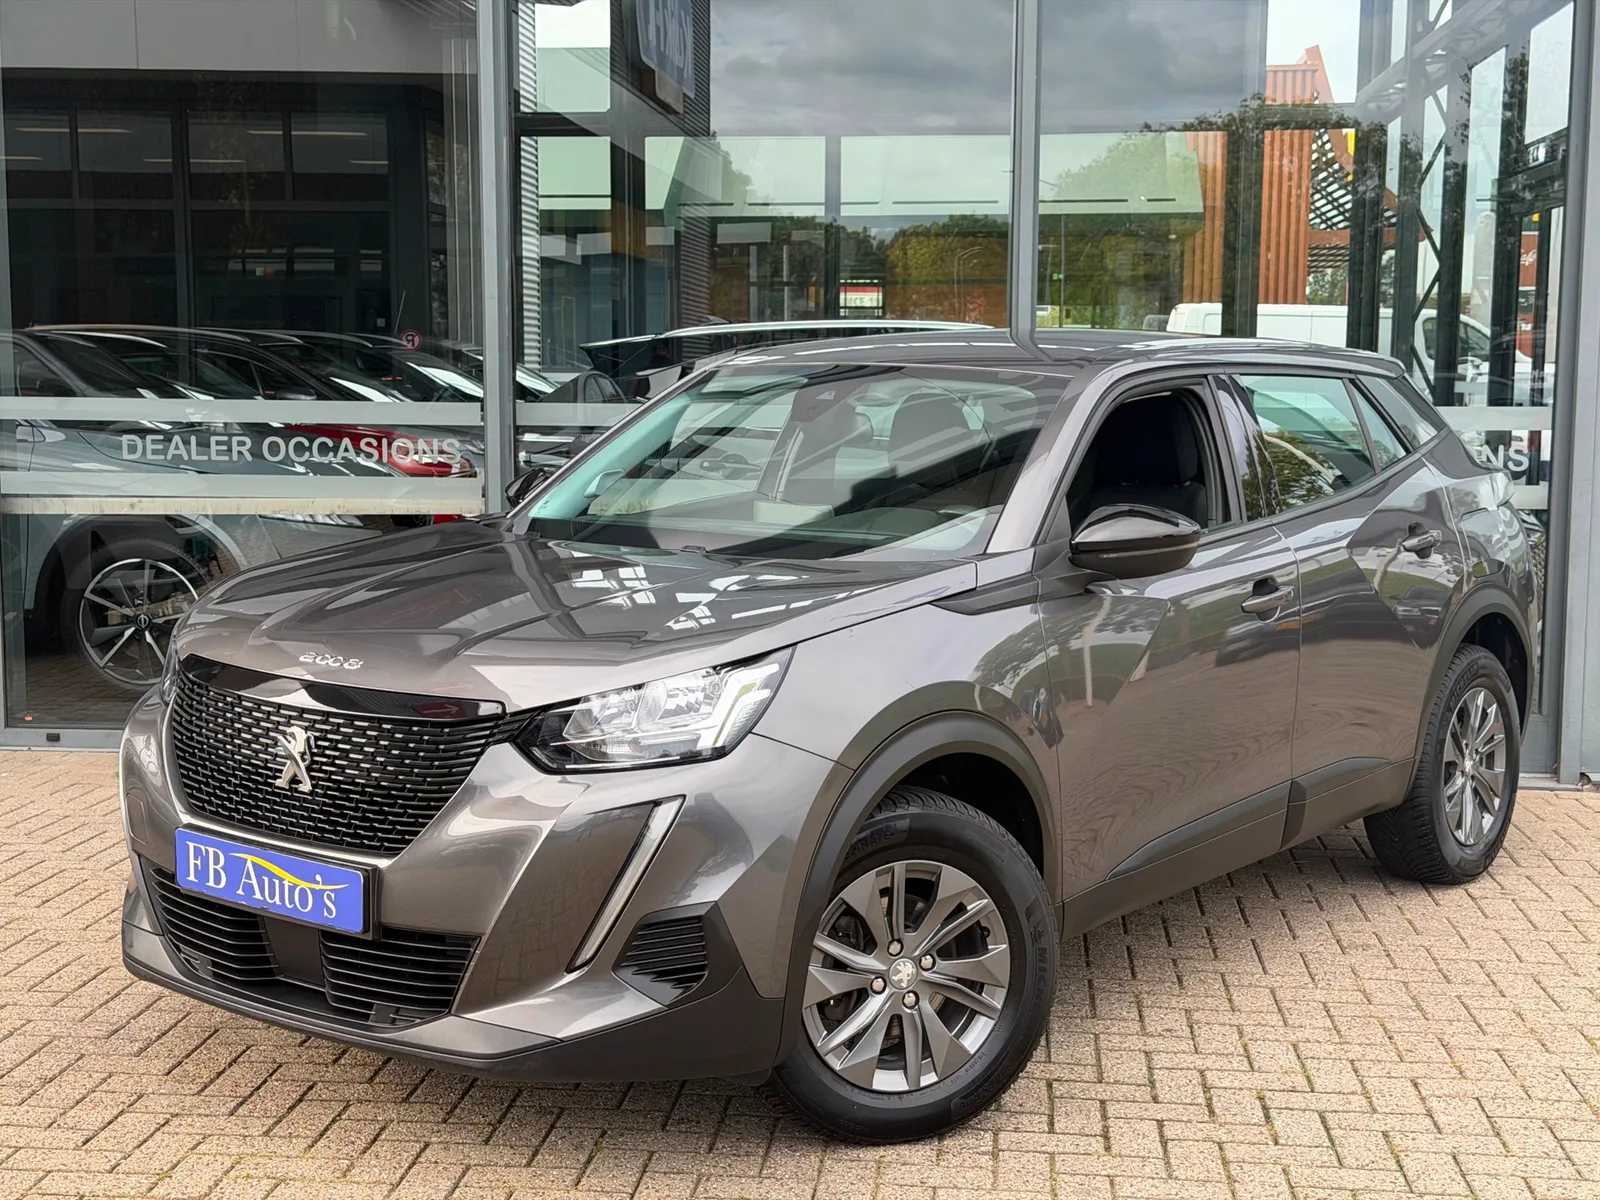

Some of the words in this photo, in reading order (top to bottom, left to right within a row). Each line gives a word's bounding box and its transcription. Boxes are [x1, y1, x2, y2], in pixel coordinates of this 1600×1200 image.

[121, 434, 253, 462] DEALER
[261, 435, 462, 464] OCCASIONS
[298, 651, 364, 669] 2008
[184, 840, 228, 890] FB
[235, 857, 338, 919] Auto's
